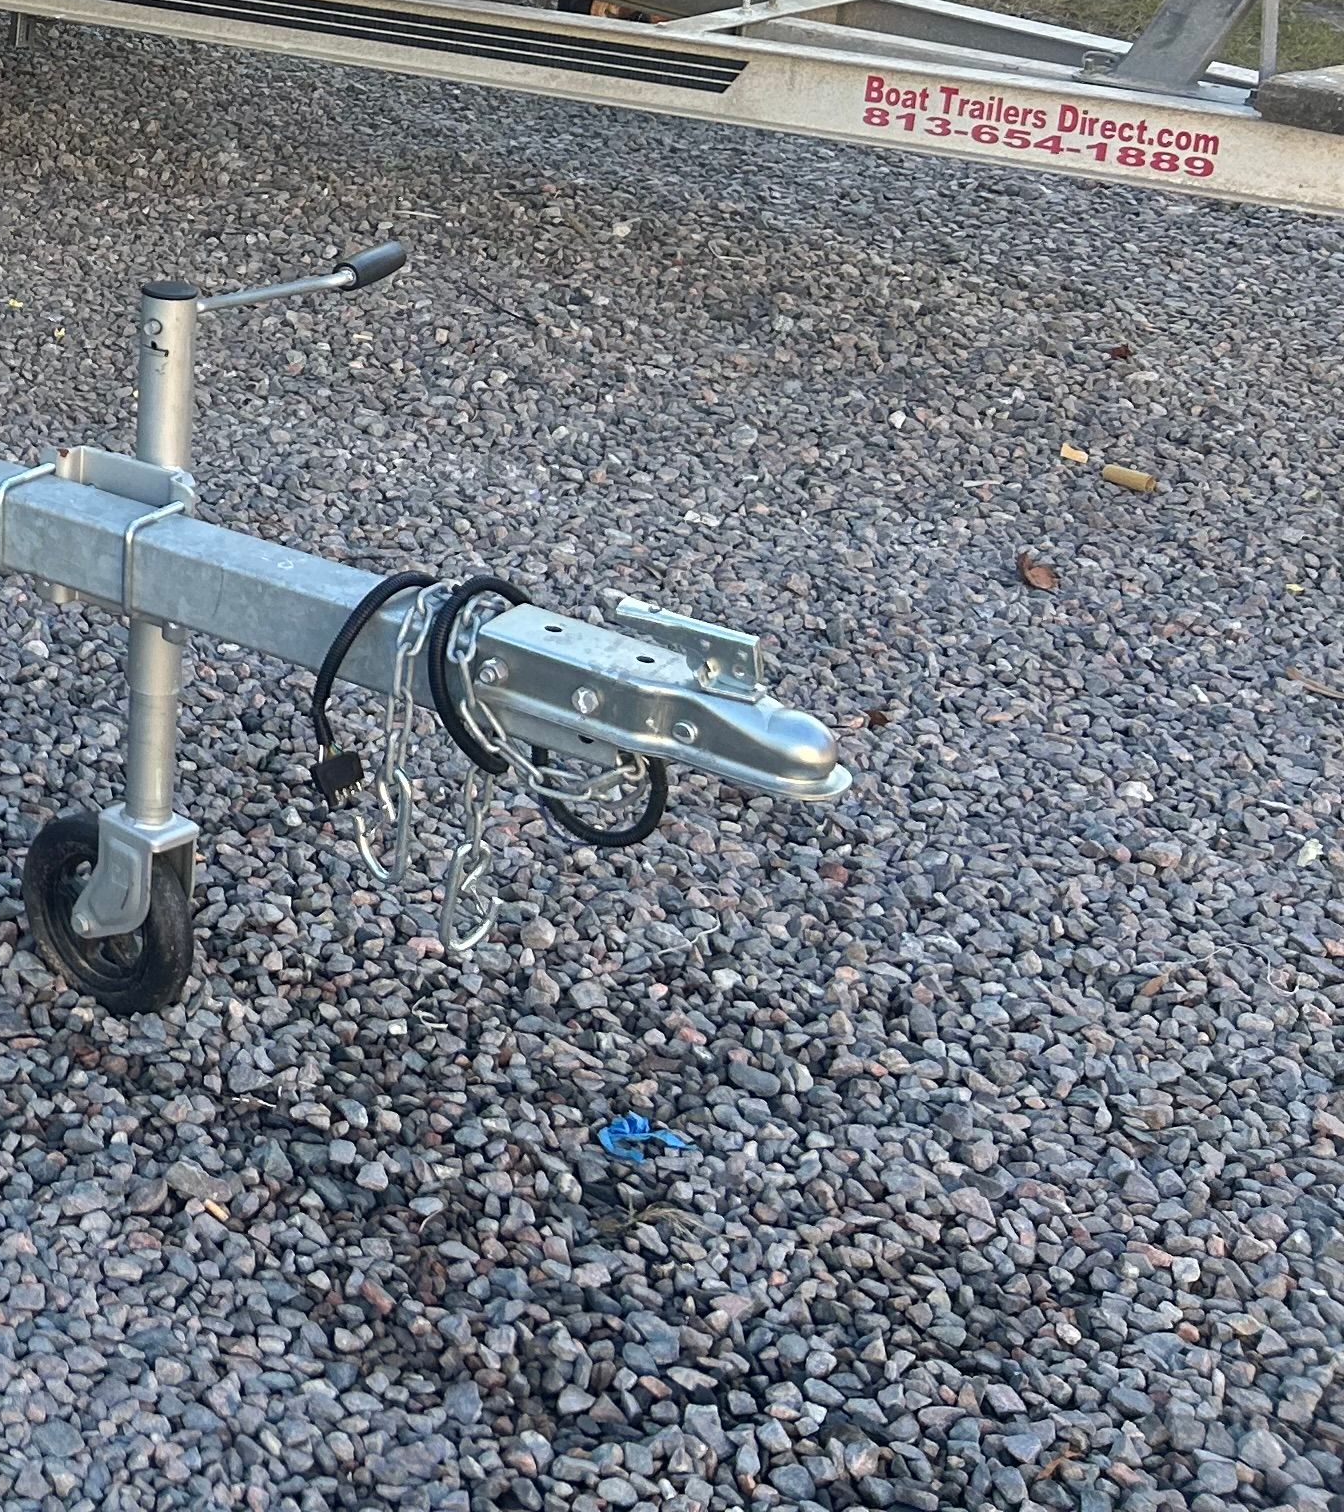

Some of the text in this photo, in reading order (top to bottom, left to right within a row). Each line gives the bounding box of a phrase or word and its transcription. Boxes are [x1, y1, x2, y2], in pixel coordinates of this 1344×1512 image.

[862, 106, 1216, 178] 813-654-1889
[864, 75, 1220, 155] Boat Trailers Direct.com
